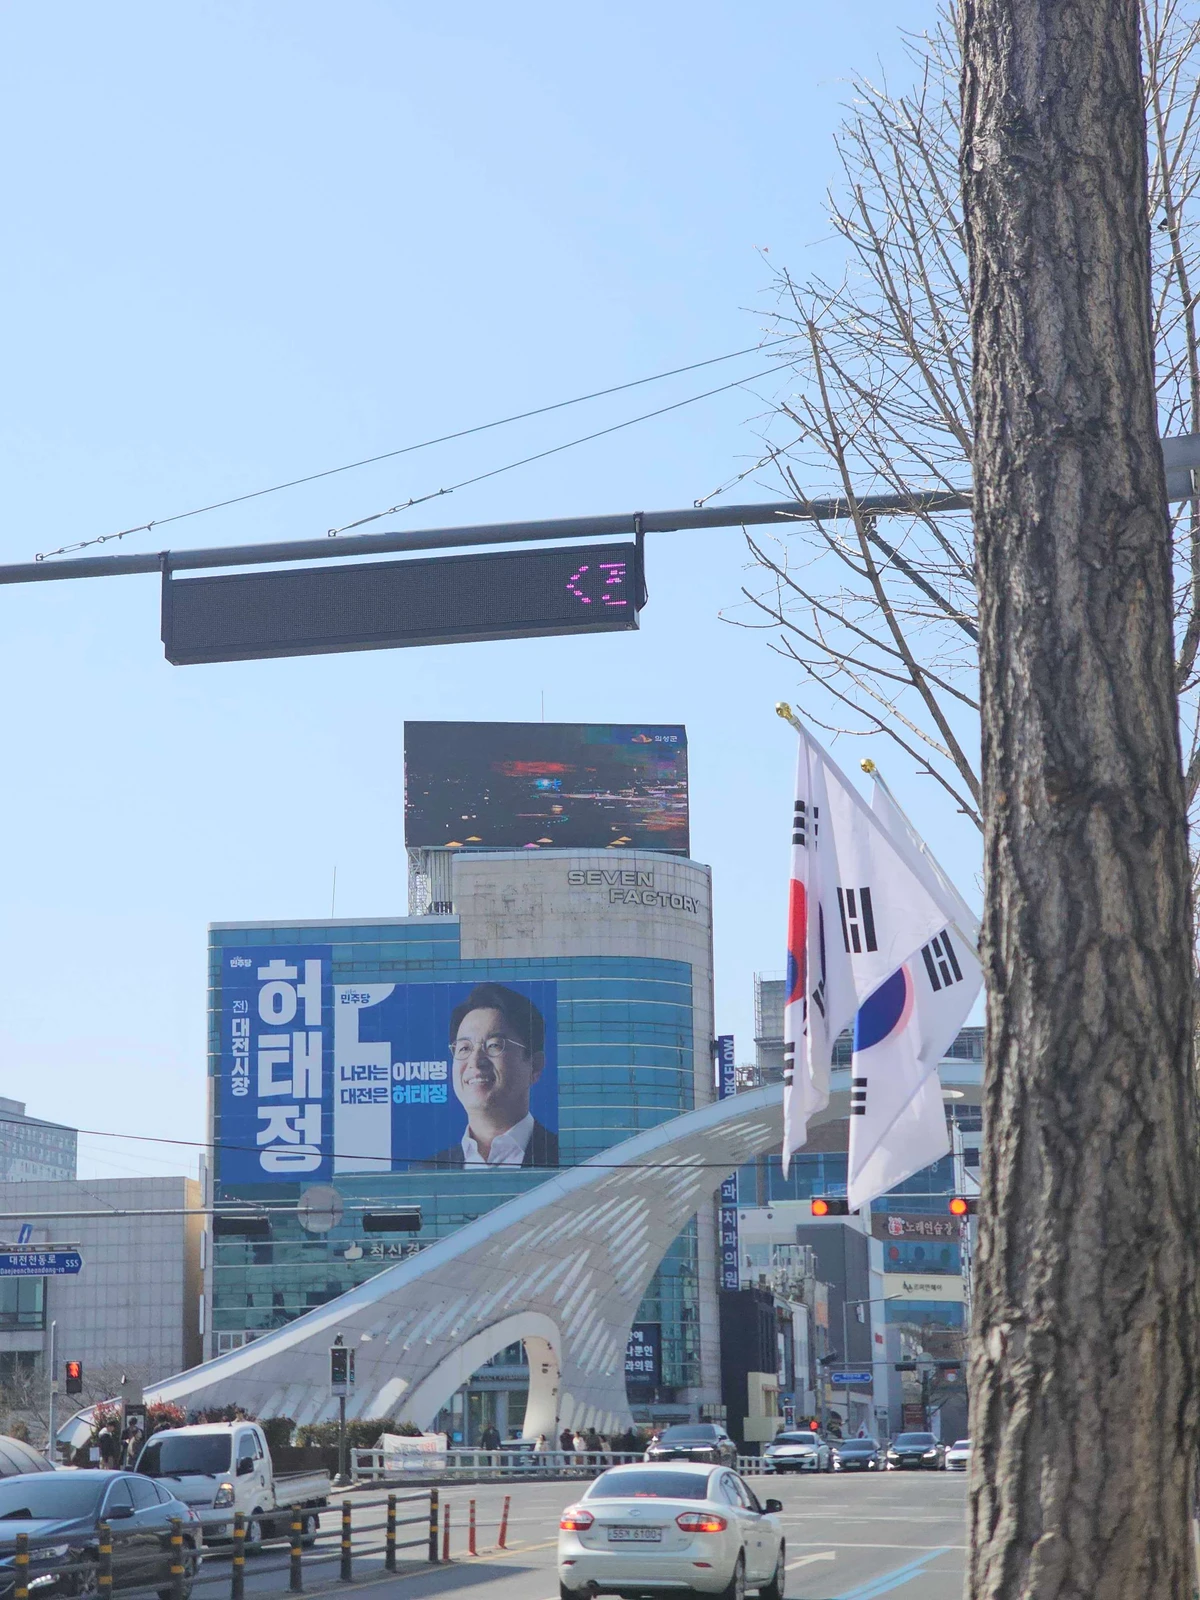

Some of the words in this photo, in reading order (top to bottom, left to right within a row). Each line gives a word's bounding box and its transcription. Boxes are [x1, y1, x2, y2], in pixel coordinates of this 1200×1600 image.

[654, 735, 678, 743] 의성군
[567, 869, 655, 888] SEVEN
[609, 887, 701, 914] FACTORY
[229, 959, 252, 968] 민주당
[232, 1000, 248, 1014] 전)
[340, 993, 371, 1005] 민주당
[231, 1017, 250, 1097] 대전시장
[256, 959, 323, 1173] 허태정
[724, 1039, 735, 1074] FLOW
[340, 1064, 389, 1081] 나라는
[392, 1061, 448, 1081] 이재명
[340, 1087, 389, 1105] 대전은
[392, 1084, 448, 1104] 허태정
[905, 1221, 954, 1236] 노래연습장
[370, 1243, 433, 1259] 척신경
[723, 1210, 738, 1288] 치과의원
[9, 1254, 57, 1266] 대전천동로
